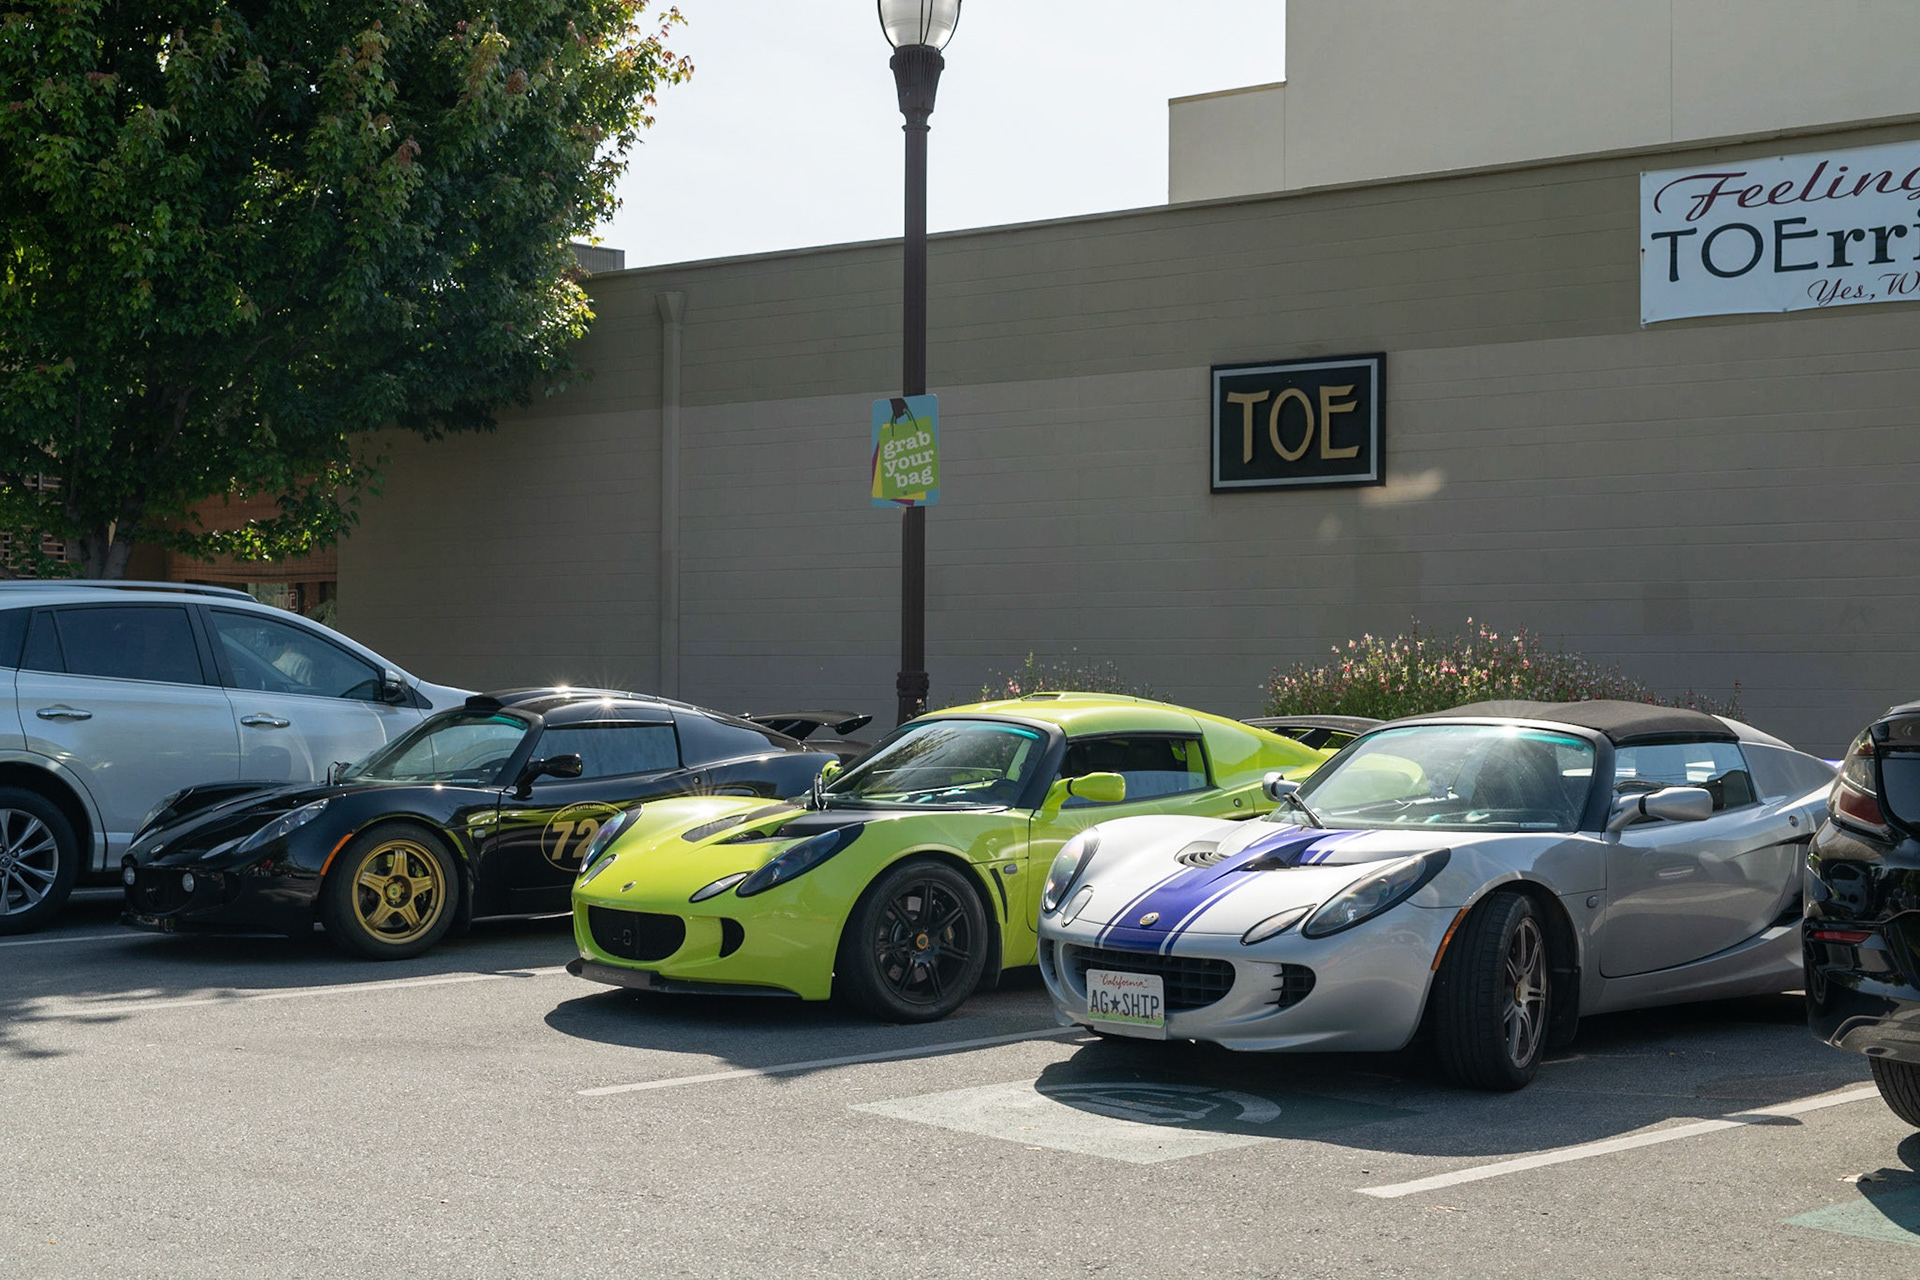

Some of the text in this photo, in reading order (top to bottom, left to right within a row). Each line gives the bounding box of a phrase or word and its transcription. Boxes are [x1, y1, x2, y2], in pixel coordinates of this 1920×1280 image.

[1807, 278, 1876, 307] Yes,
[1227, 384, 1361, 464] TOE
[883, 431, 931, 459] grab
[884, 449, 934, 477] your
[894, 466, 934, 488] bag
[590, 803, 605, 811] LOTUS
[551, 818, 600, 860] 72
[1102, 973, 1148, 989] California
